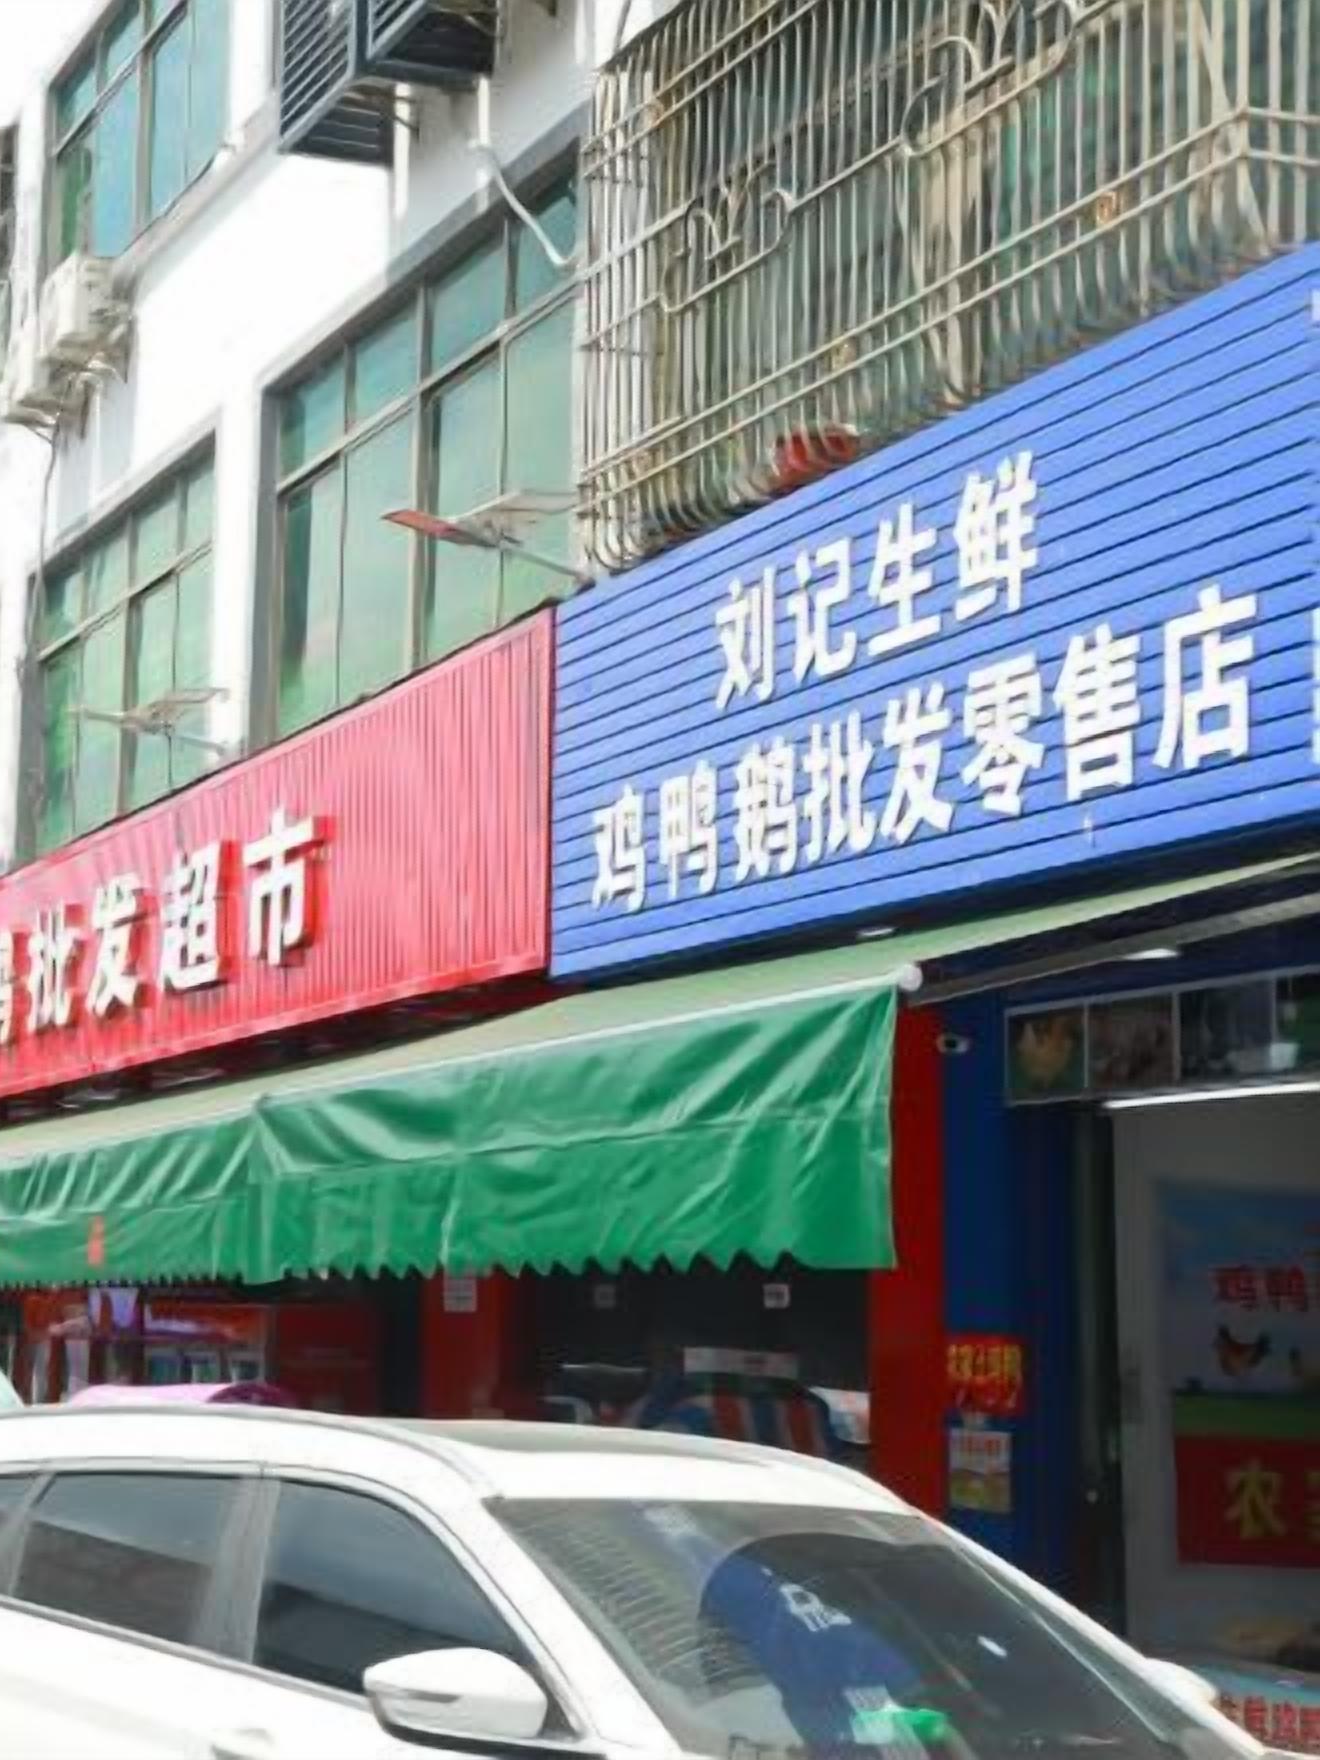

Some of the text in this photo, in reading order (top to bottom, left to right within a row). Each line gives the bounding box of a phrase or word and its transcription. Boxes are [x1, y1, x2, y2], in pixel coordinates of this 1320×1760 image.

[714, 450, 1039, 711] 刘记生鲜
[591, 584, 1258, 913] 鸡鸭鹅批发零售店
[1212, 1262, 1320, 1312] 鸡鸭
[1223, 1458, 1320, 1538] 农
